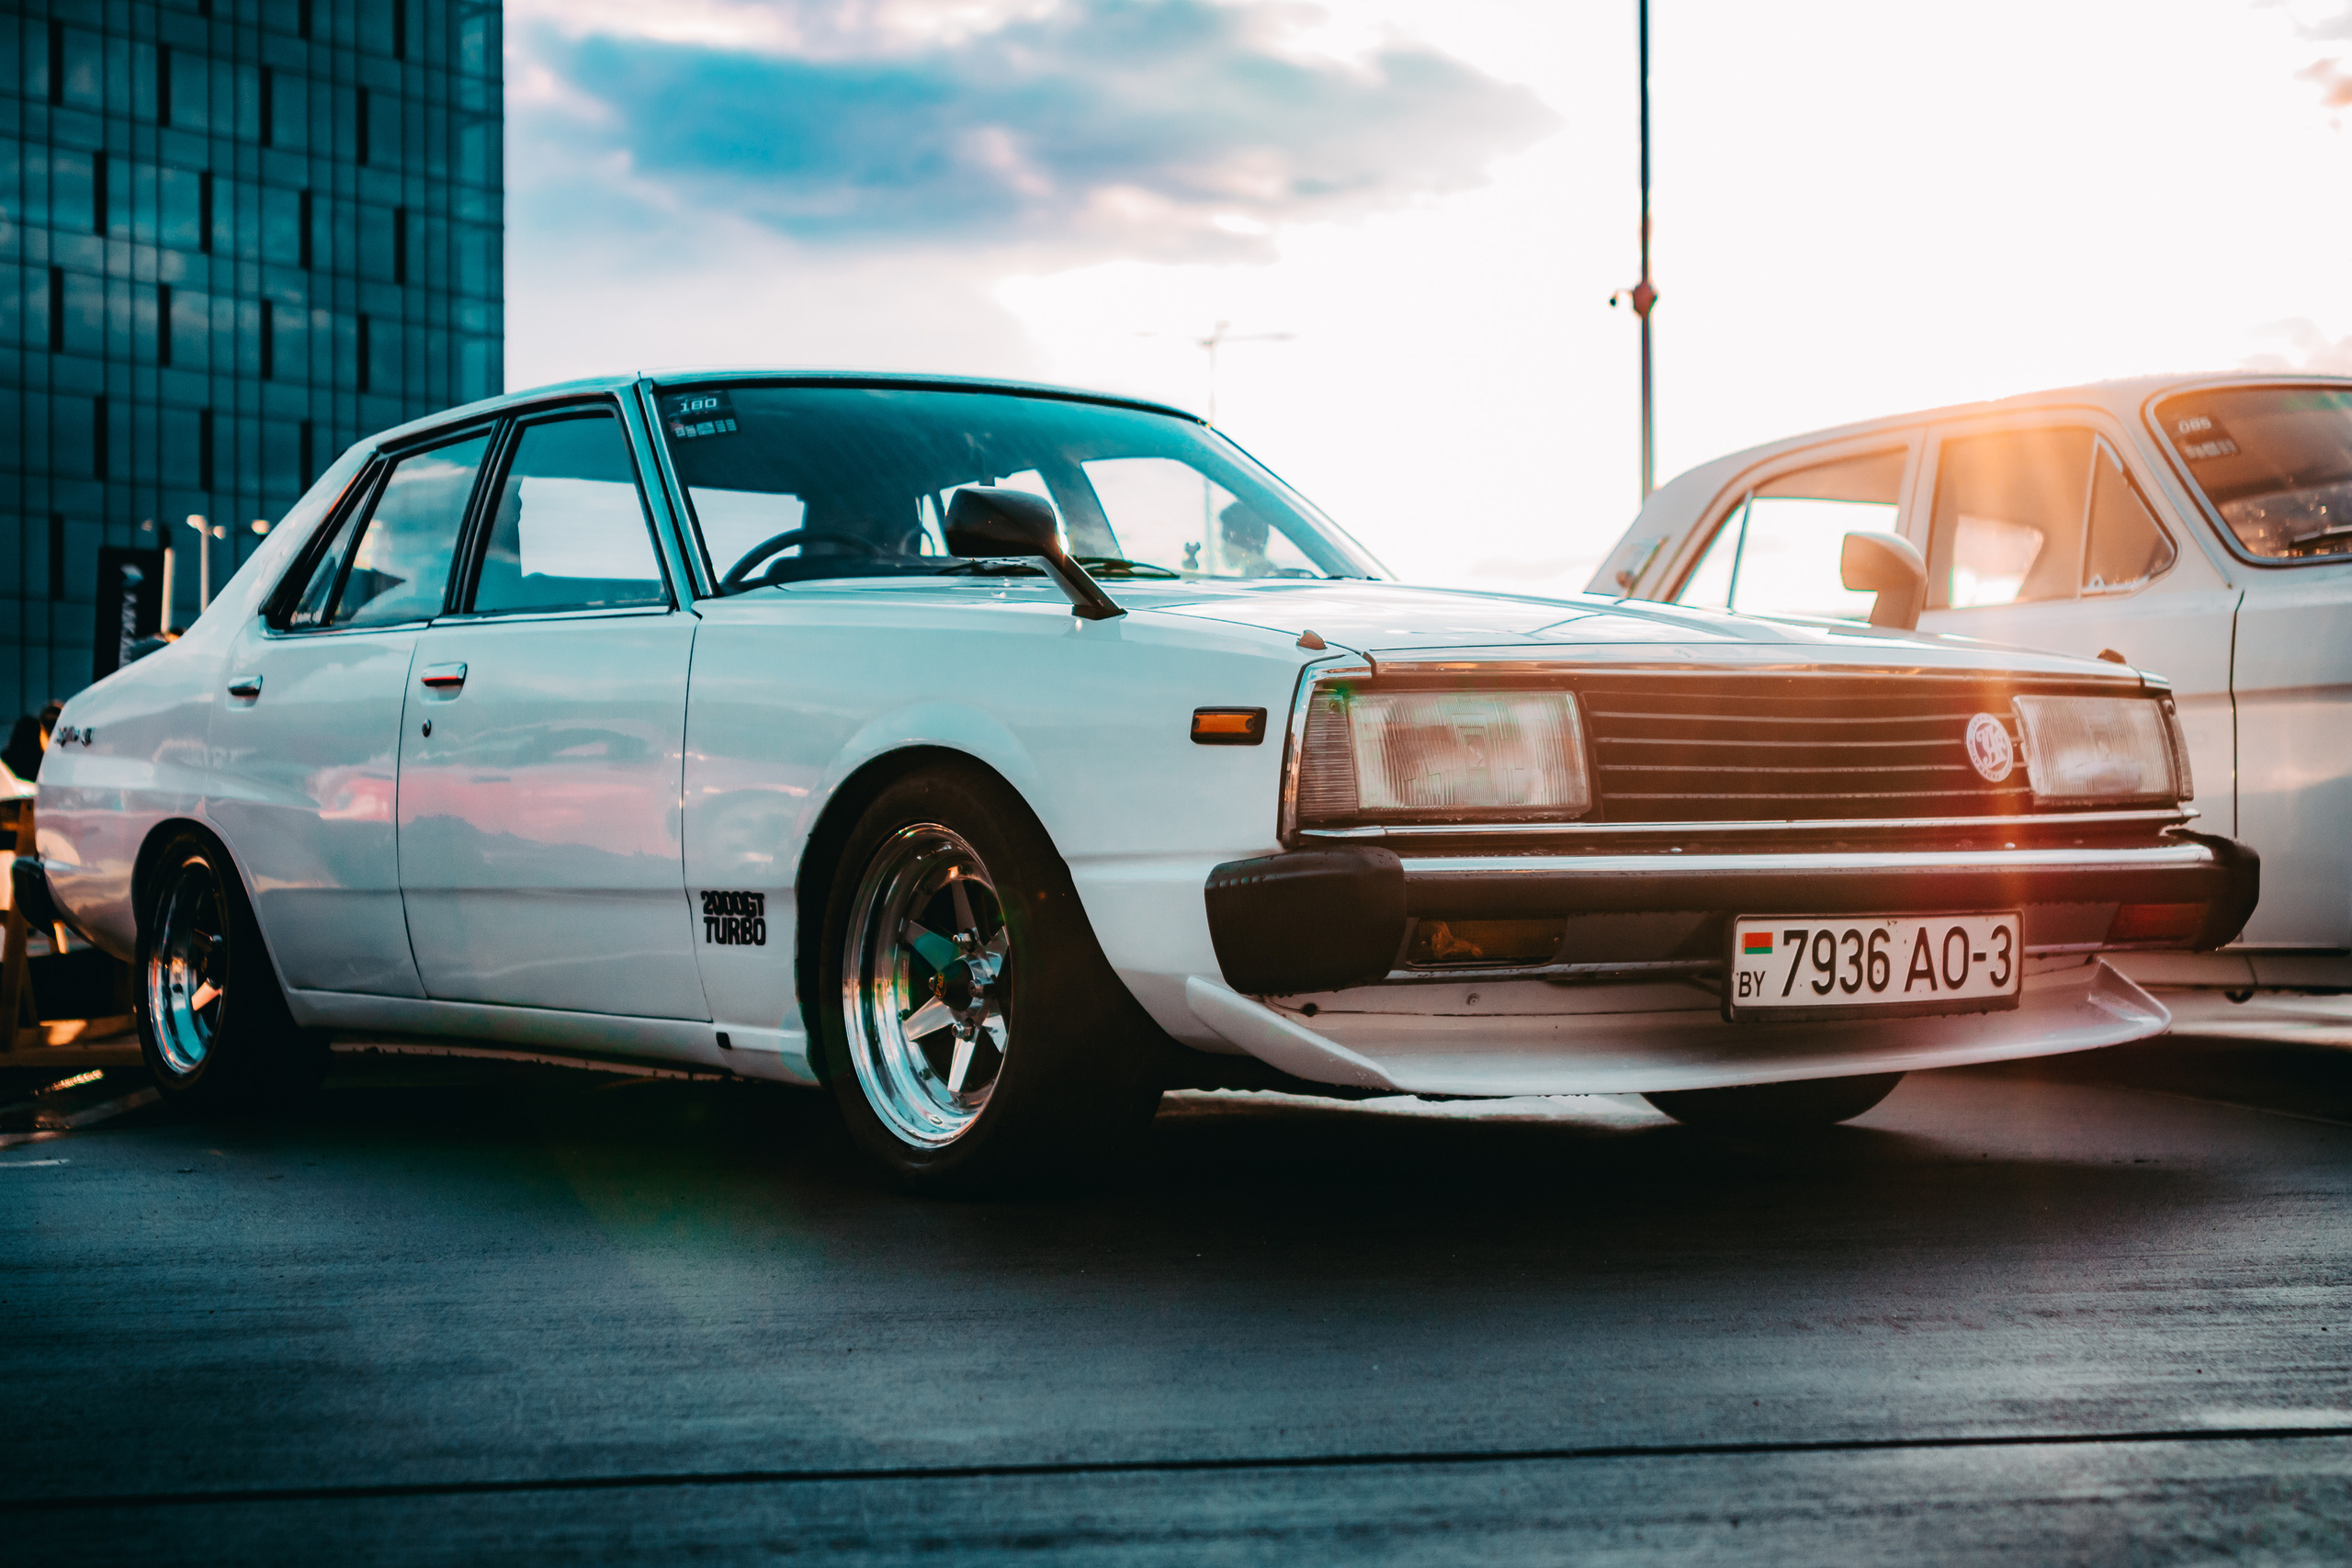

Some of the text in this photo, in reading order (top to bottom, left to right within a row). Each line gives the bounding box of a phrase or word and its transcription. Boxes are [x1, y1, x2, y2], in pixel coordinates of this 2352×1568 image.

[700, 890, 764, 919] 2000GT
[703, 916, 766, 946] TURBO
[1781, 928, 1891, 998] 7936
[1737, 970, 1766, 998] BY
